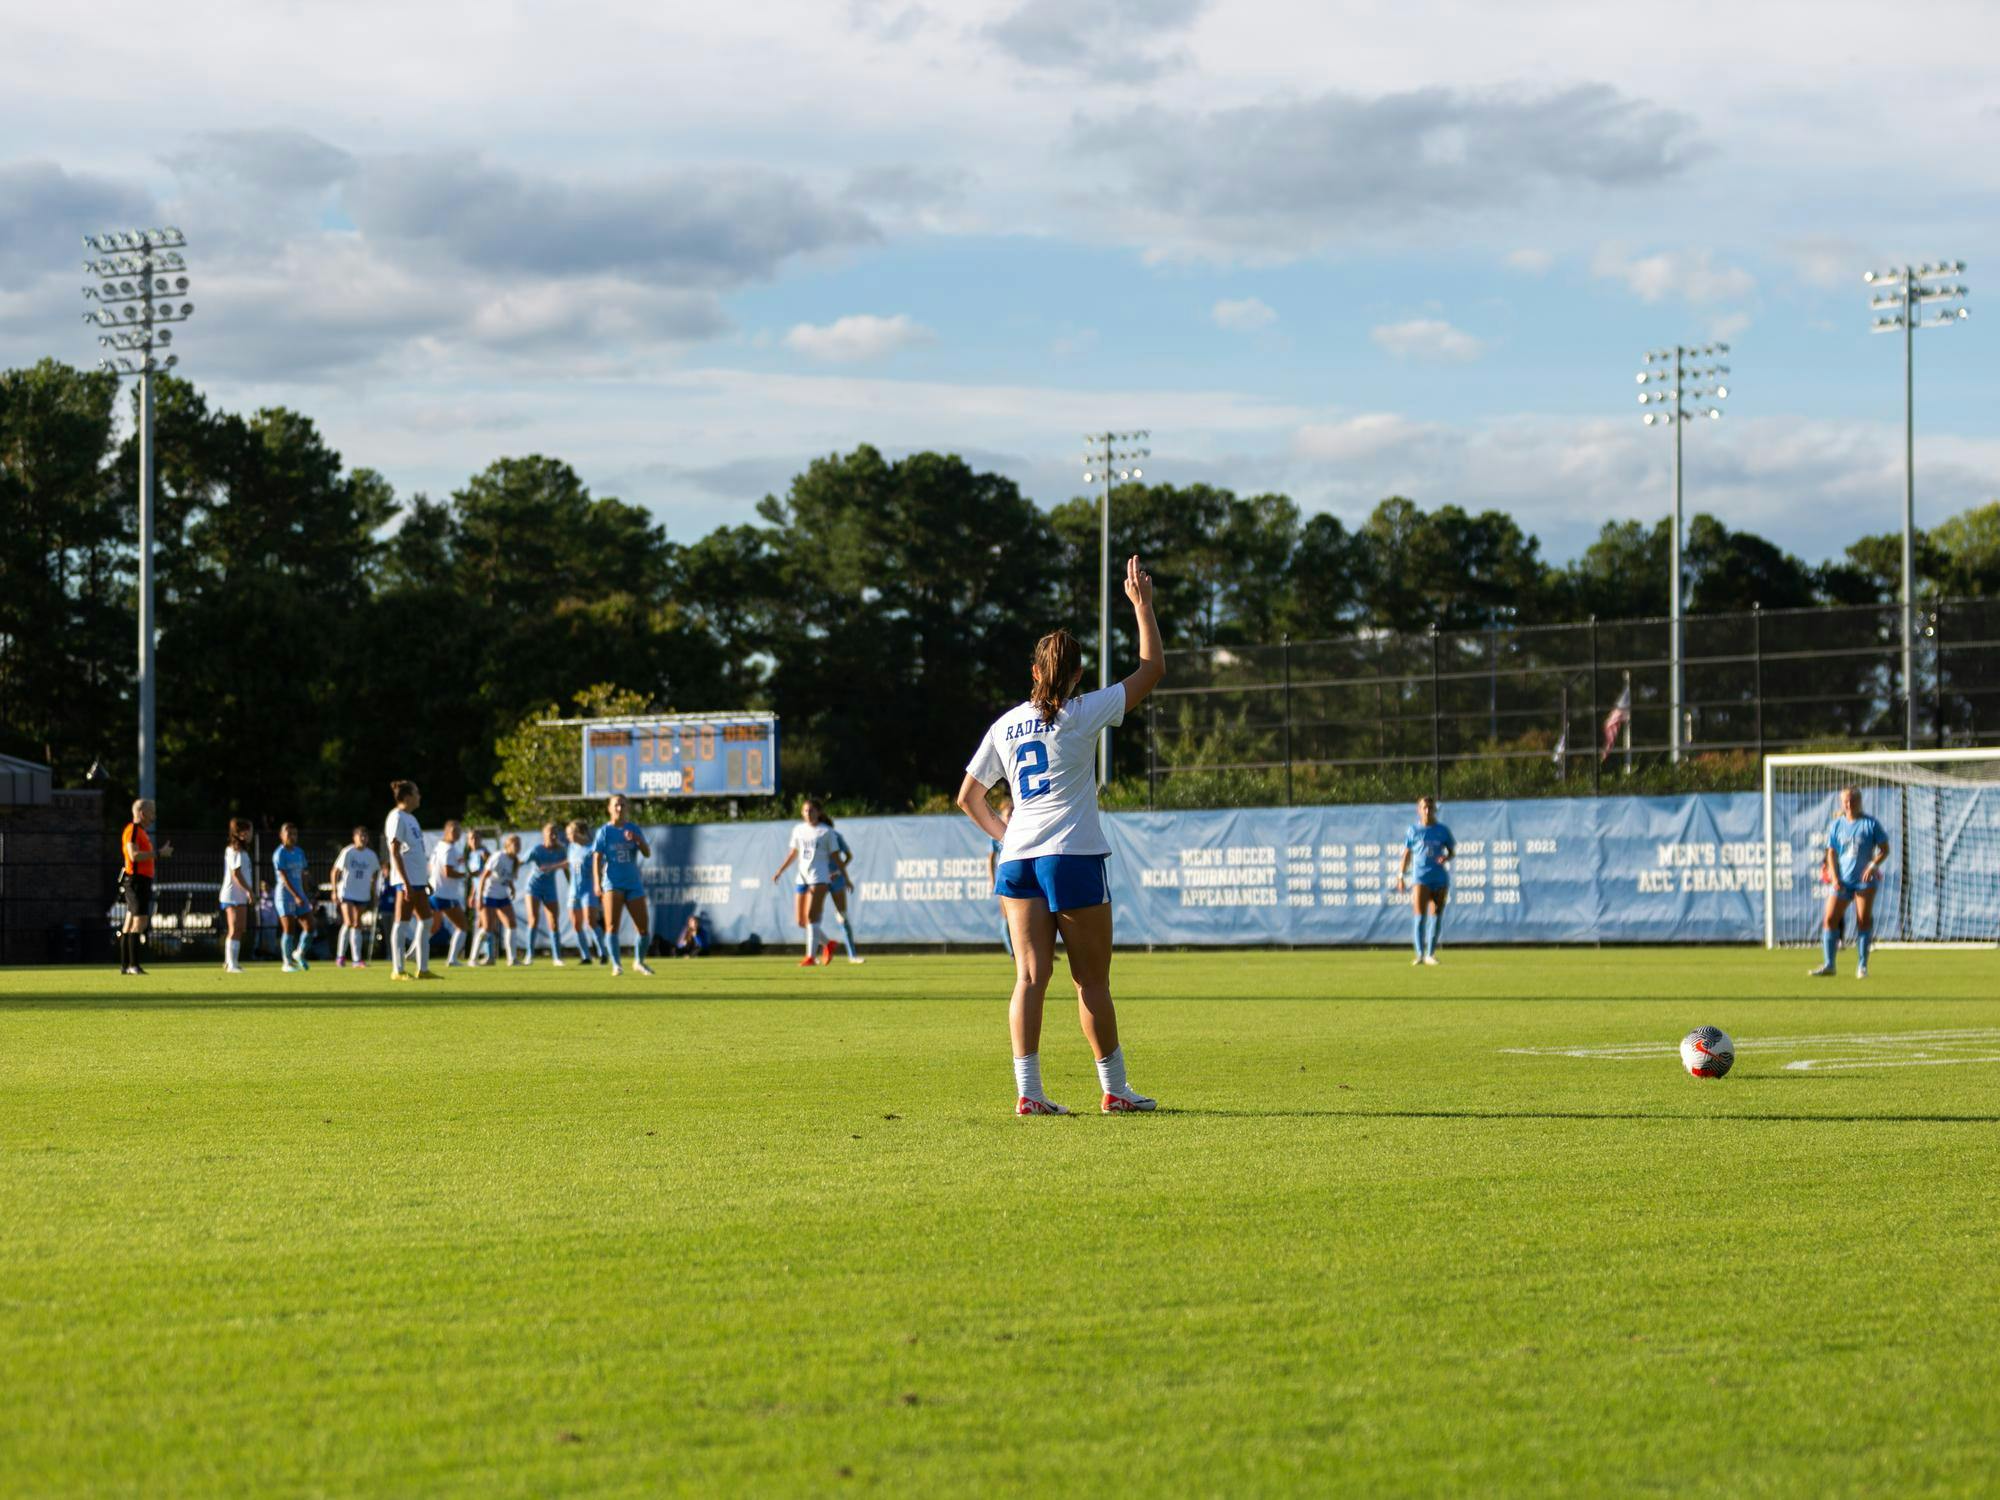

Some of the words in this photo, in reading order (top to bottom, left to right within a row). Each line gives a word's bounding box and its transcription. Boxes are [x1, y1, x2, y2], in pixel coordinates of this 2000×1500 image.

[1005, 718, 1056, 741] RADER
[639, 771, 682, 789] PERIOD
[682, 765, 695, 793] 2
[1016, 740, 1051, 800] 2
[1181, 848, 1222, 867] MEN'S
[1227, 846, 1276, 865] SOCCER
[1287, 845, 1312, 859] 1972
[1455, 842, 1485, 855] 2007
[1492, 841, 1518, 855] 2011
[1526, 839, 1557, 854] 2022
[1657, 844, 1715, 867] MEN'S
[684, 864, 732, 884] SOCCER
[896, 858, 938, 878] MEN'S
[1287, 862, 1314, 875] 1980
[1455, 858, 1487, 872] 2008
[1492, 857, 1520, 871] 2017
[1141, 869, 1178, 887] NCAA
[1183, 867, 1276, 887] TOURNAMENT
[1455, 875, 1487, 888] 2009
[1638, 870, 1674, 893] ACC
[654, 885, 730, 905] CHAMPIONS
[860, 882, 898, 901] NCAA
[903, 881, 963, 901] COLLEGE
[1181, 887, 1278, 907] APPEARANCES
[1287, 893, 1315, 907] 1982
[1455, 891, 1485, 904] 2010
[1493, 889, 1521, 904] 2021
